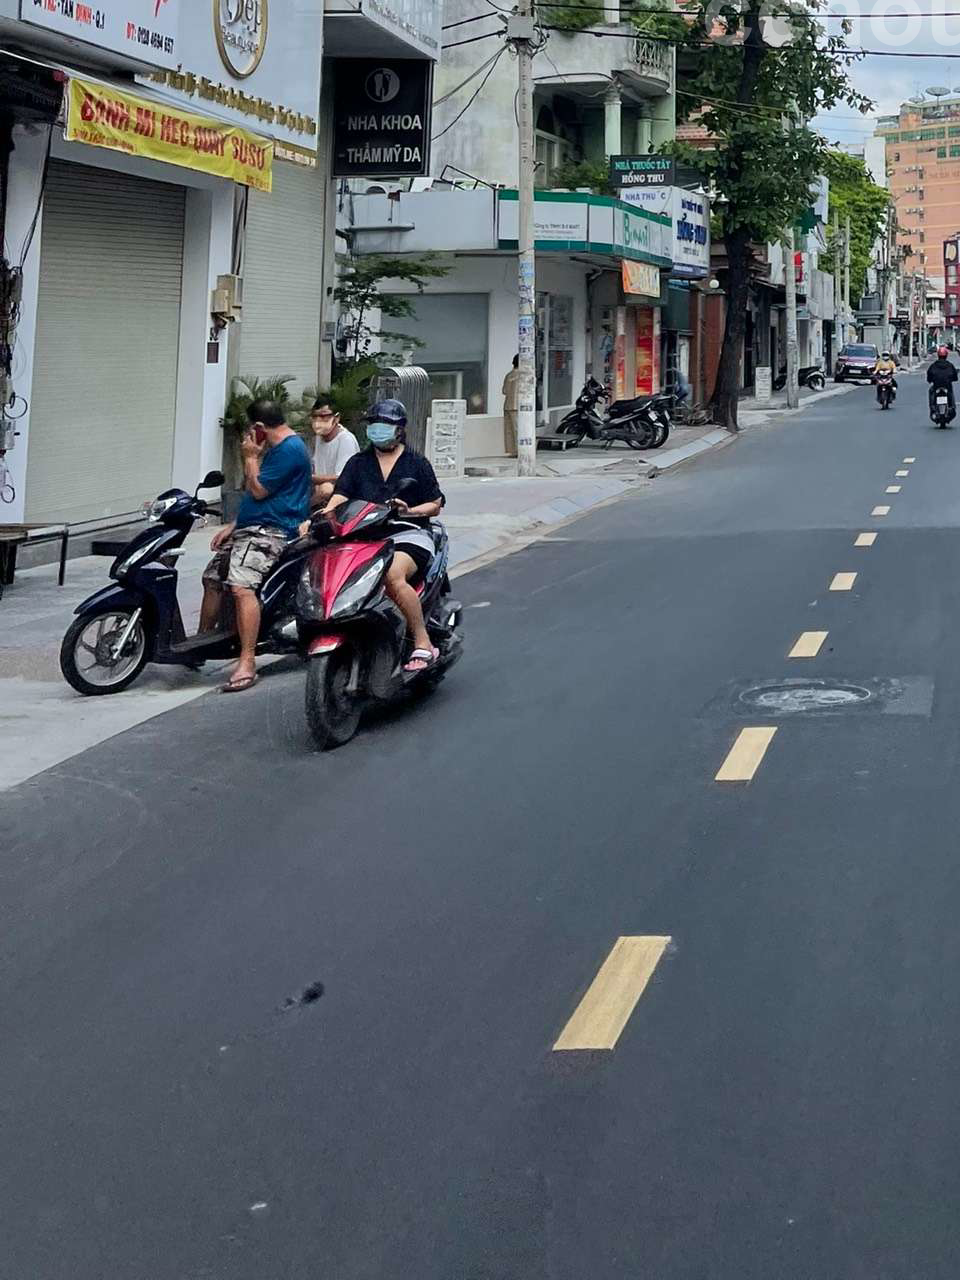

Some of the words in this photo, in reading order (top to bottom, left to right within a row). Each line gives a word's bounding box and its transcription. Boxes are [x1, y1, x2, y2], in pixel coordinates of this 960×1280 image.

[348, 115, 378, 131] NHA
[381, 114, 422, 130] KHOA
[383, 144, 402, 163] MỸ
[403, 146, 421, 162] DA
[647, 174, 665, 183] THU
